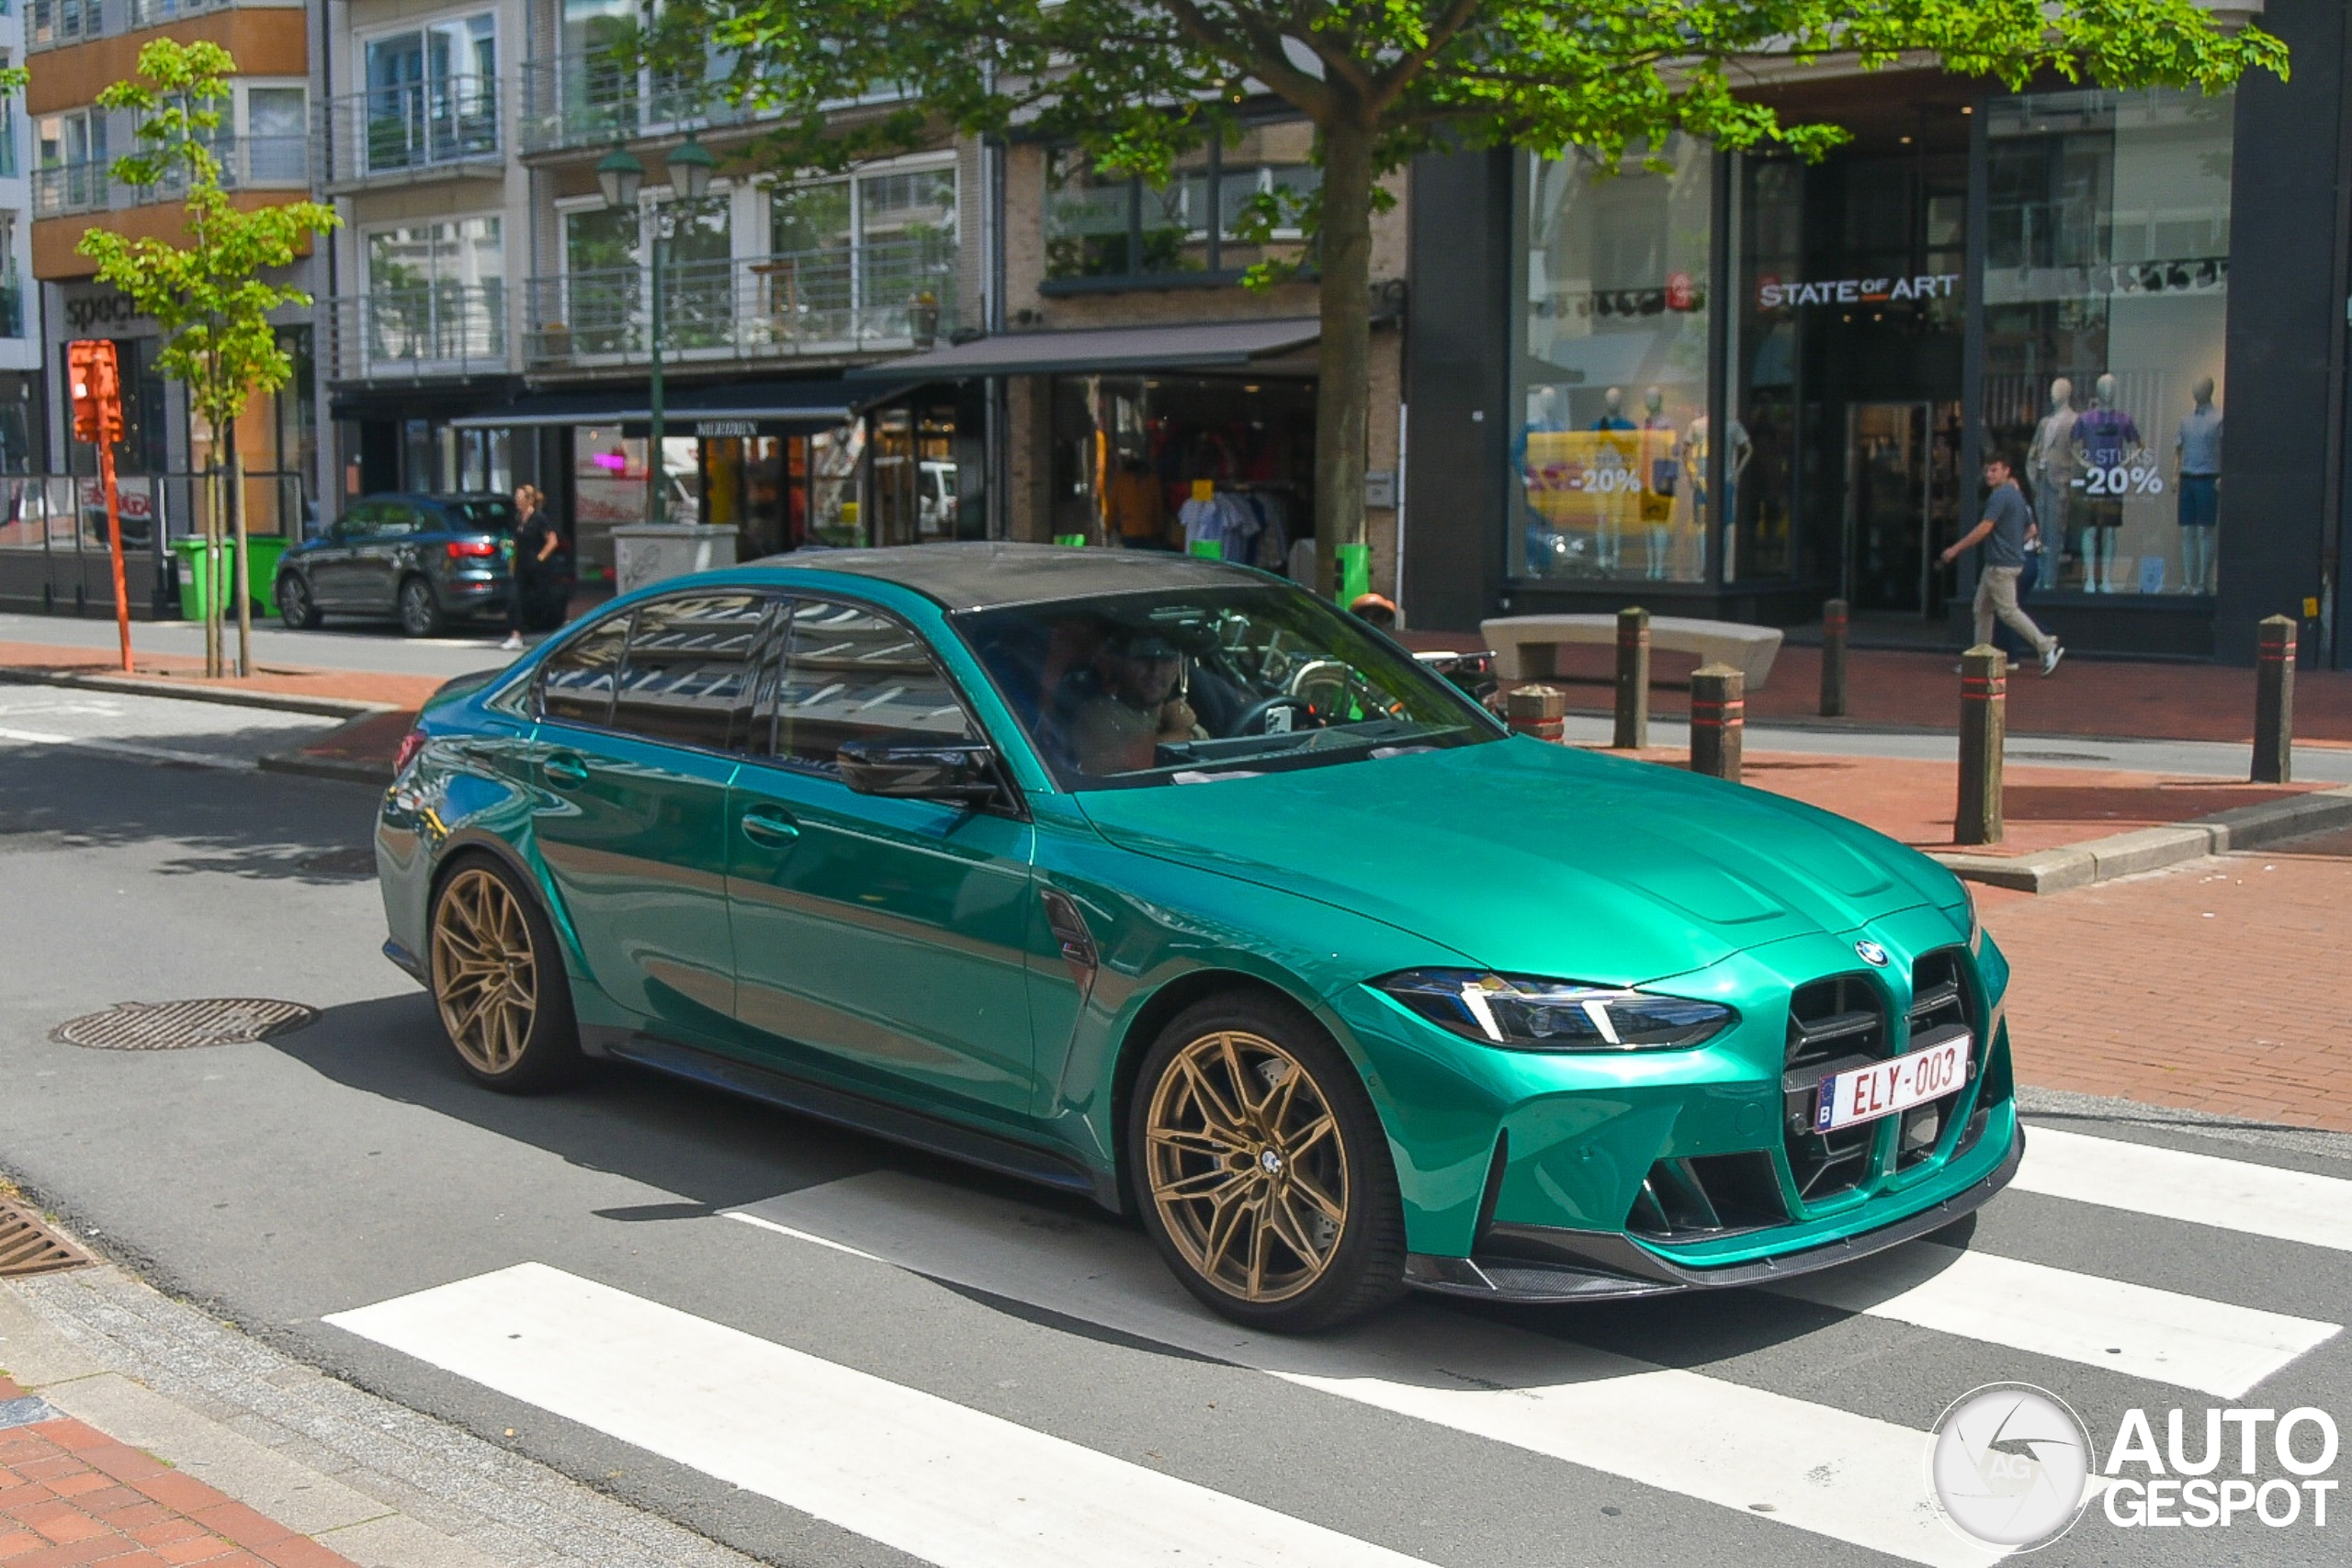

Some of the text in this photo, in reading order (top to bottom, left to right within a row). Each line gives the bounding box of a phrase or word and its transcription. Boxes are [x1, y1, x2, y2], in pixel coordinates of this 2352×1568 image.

[1759, 274, 1960, 308] STATE OF ART
[1568, 468, 1643, 494] -20%
[2069, 466, 2164, 494] -20%
[1852, 1047, 1957, 1115] ELY-003
[1818, 1105, 1831, 1124] B
